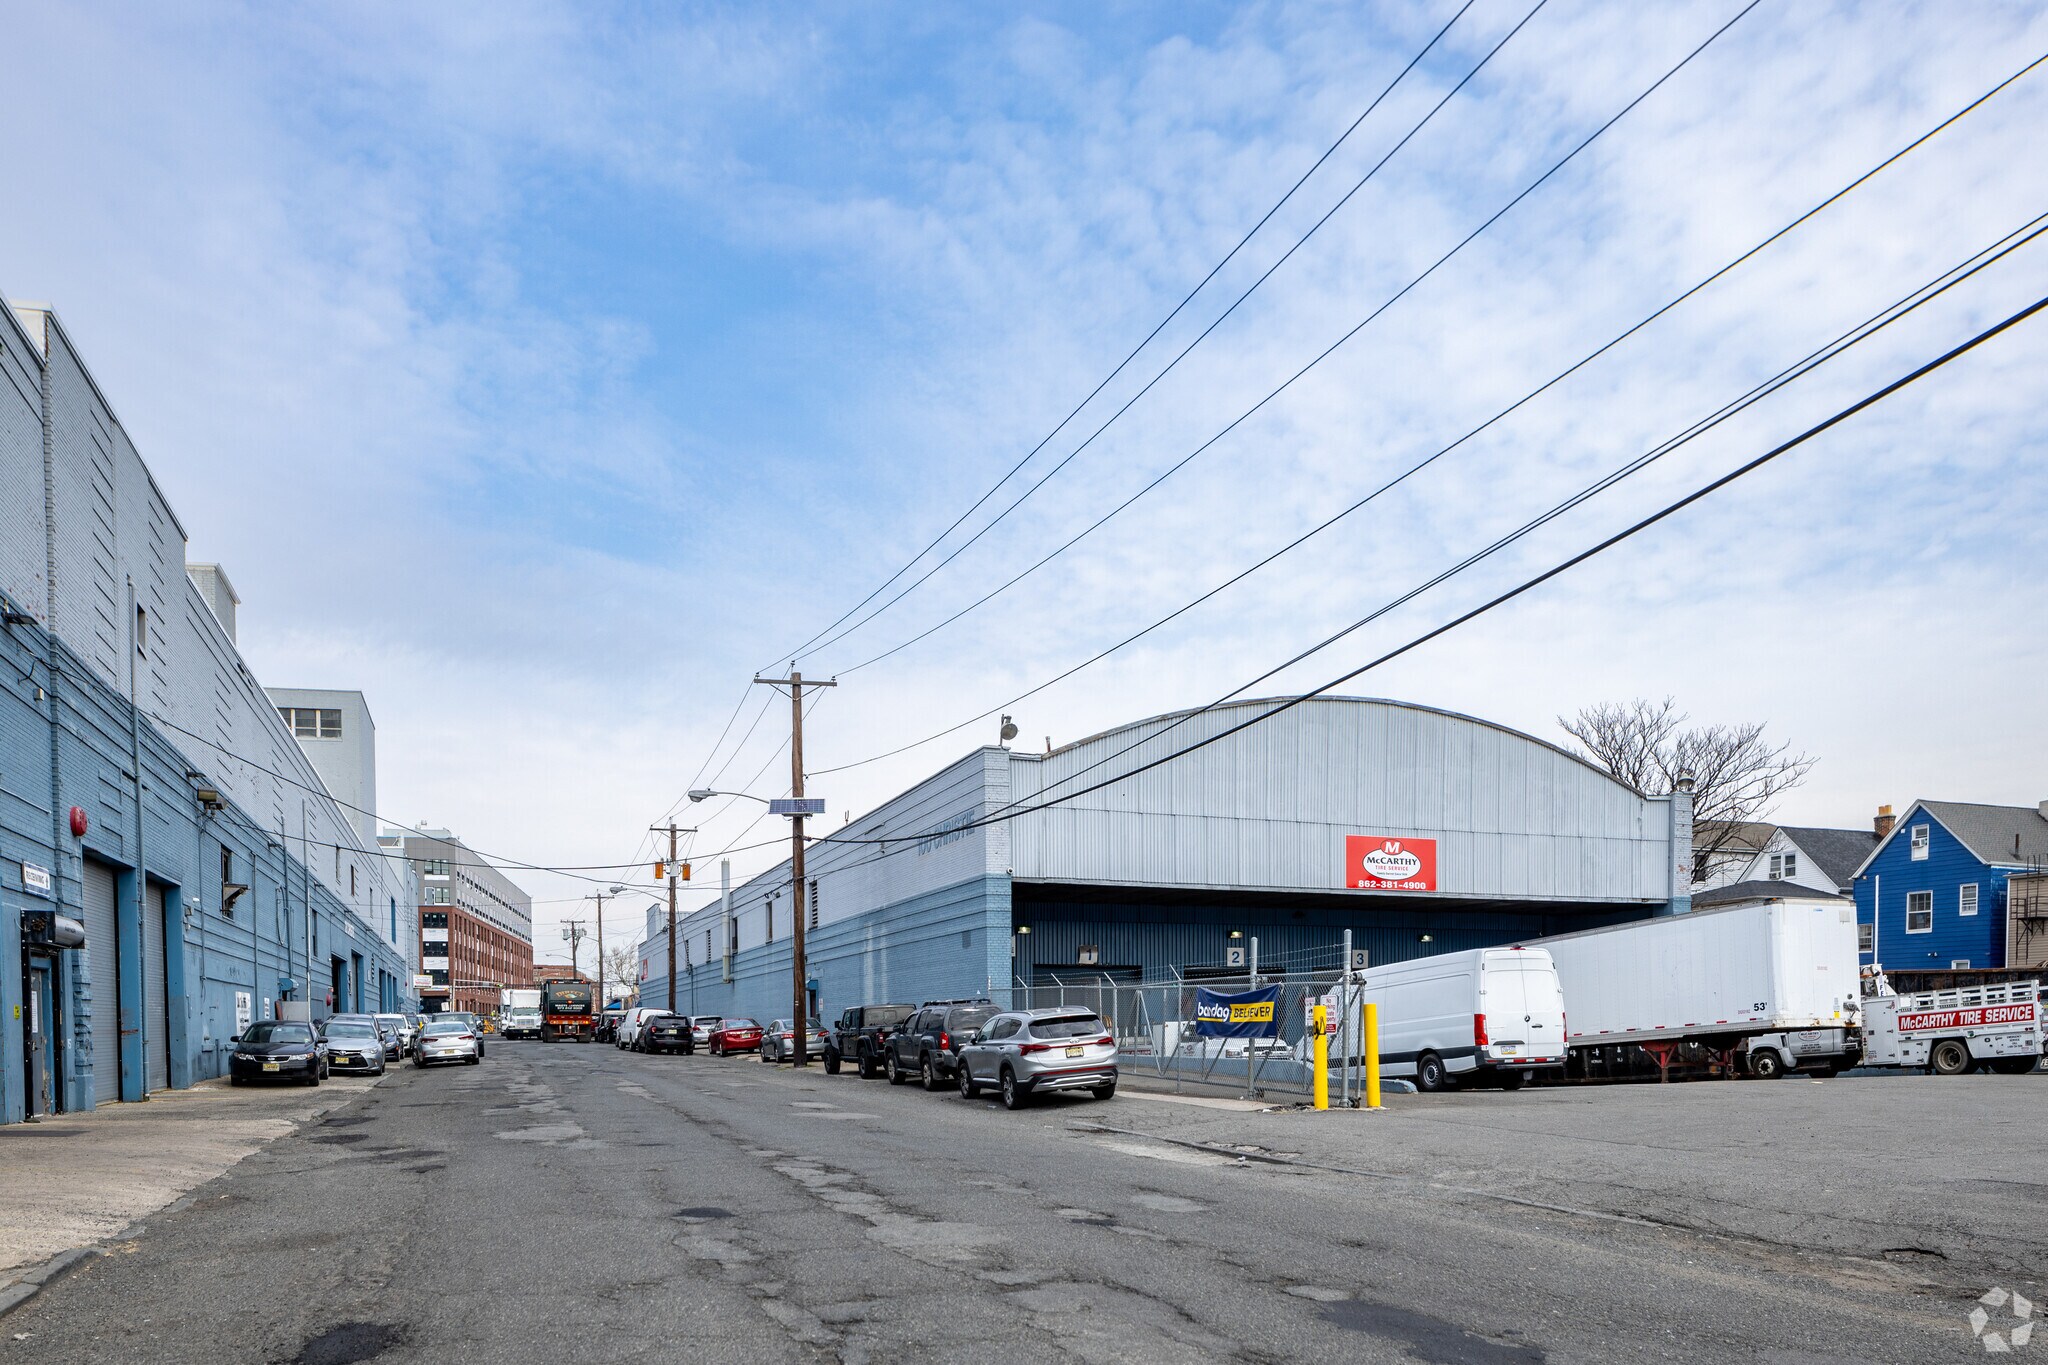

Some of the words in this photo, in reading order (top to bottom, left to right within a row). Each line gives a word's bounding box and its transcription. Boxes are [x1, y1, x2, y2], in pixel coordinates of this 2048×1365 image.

[1384, 841, 1400, 853] M
[1367, 857, 1417, 865] McCARTHY
[1358, 880, 1426, 890] 862-381-4900
[1086, 948, 1092, 961] 1
[1231, 951, 1240, 963] 2
[1356, 953, 1364, 965] 3
[1197, 1002, 1229, 1022] bandag
[1234, 1006, 1270, 1018] BELIEVER
[1900, 1012, 1956, 1030] McCARTHY
[1958, 1010, 1982, 1025] TIRE
[1985, 1005, 2033, 1022] SERVICE
